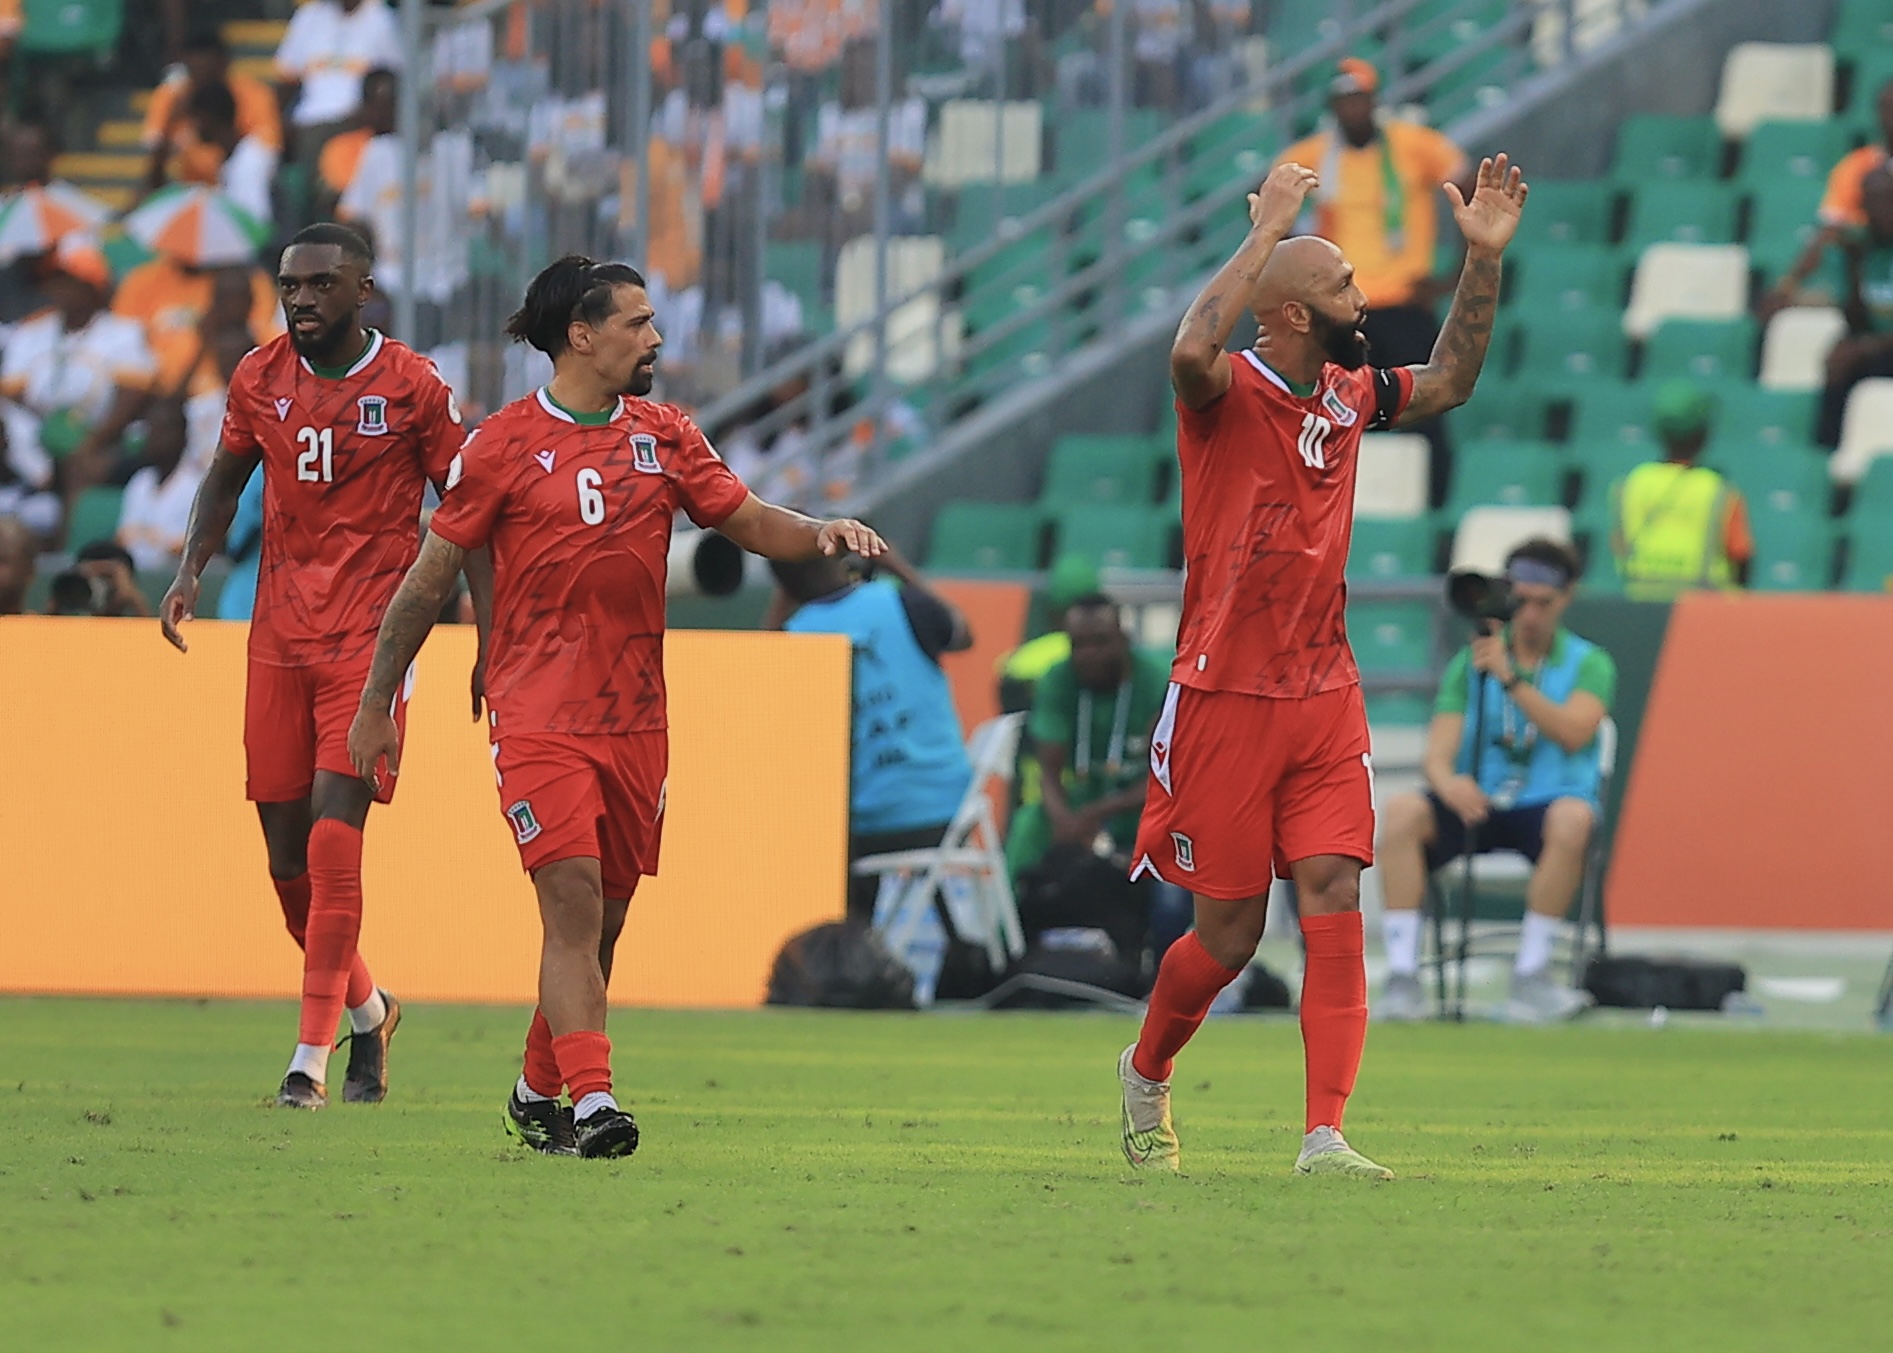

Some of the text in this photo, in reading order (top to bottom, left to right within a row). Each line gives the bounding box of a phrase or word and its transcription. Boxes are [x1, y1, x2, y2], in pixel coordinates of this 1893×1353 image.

[297, 427, 333, 483] 21
[1298, 413, 1331, 469] 10
[576, 467, 605, 526] 6
